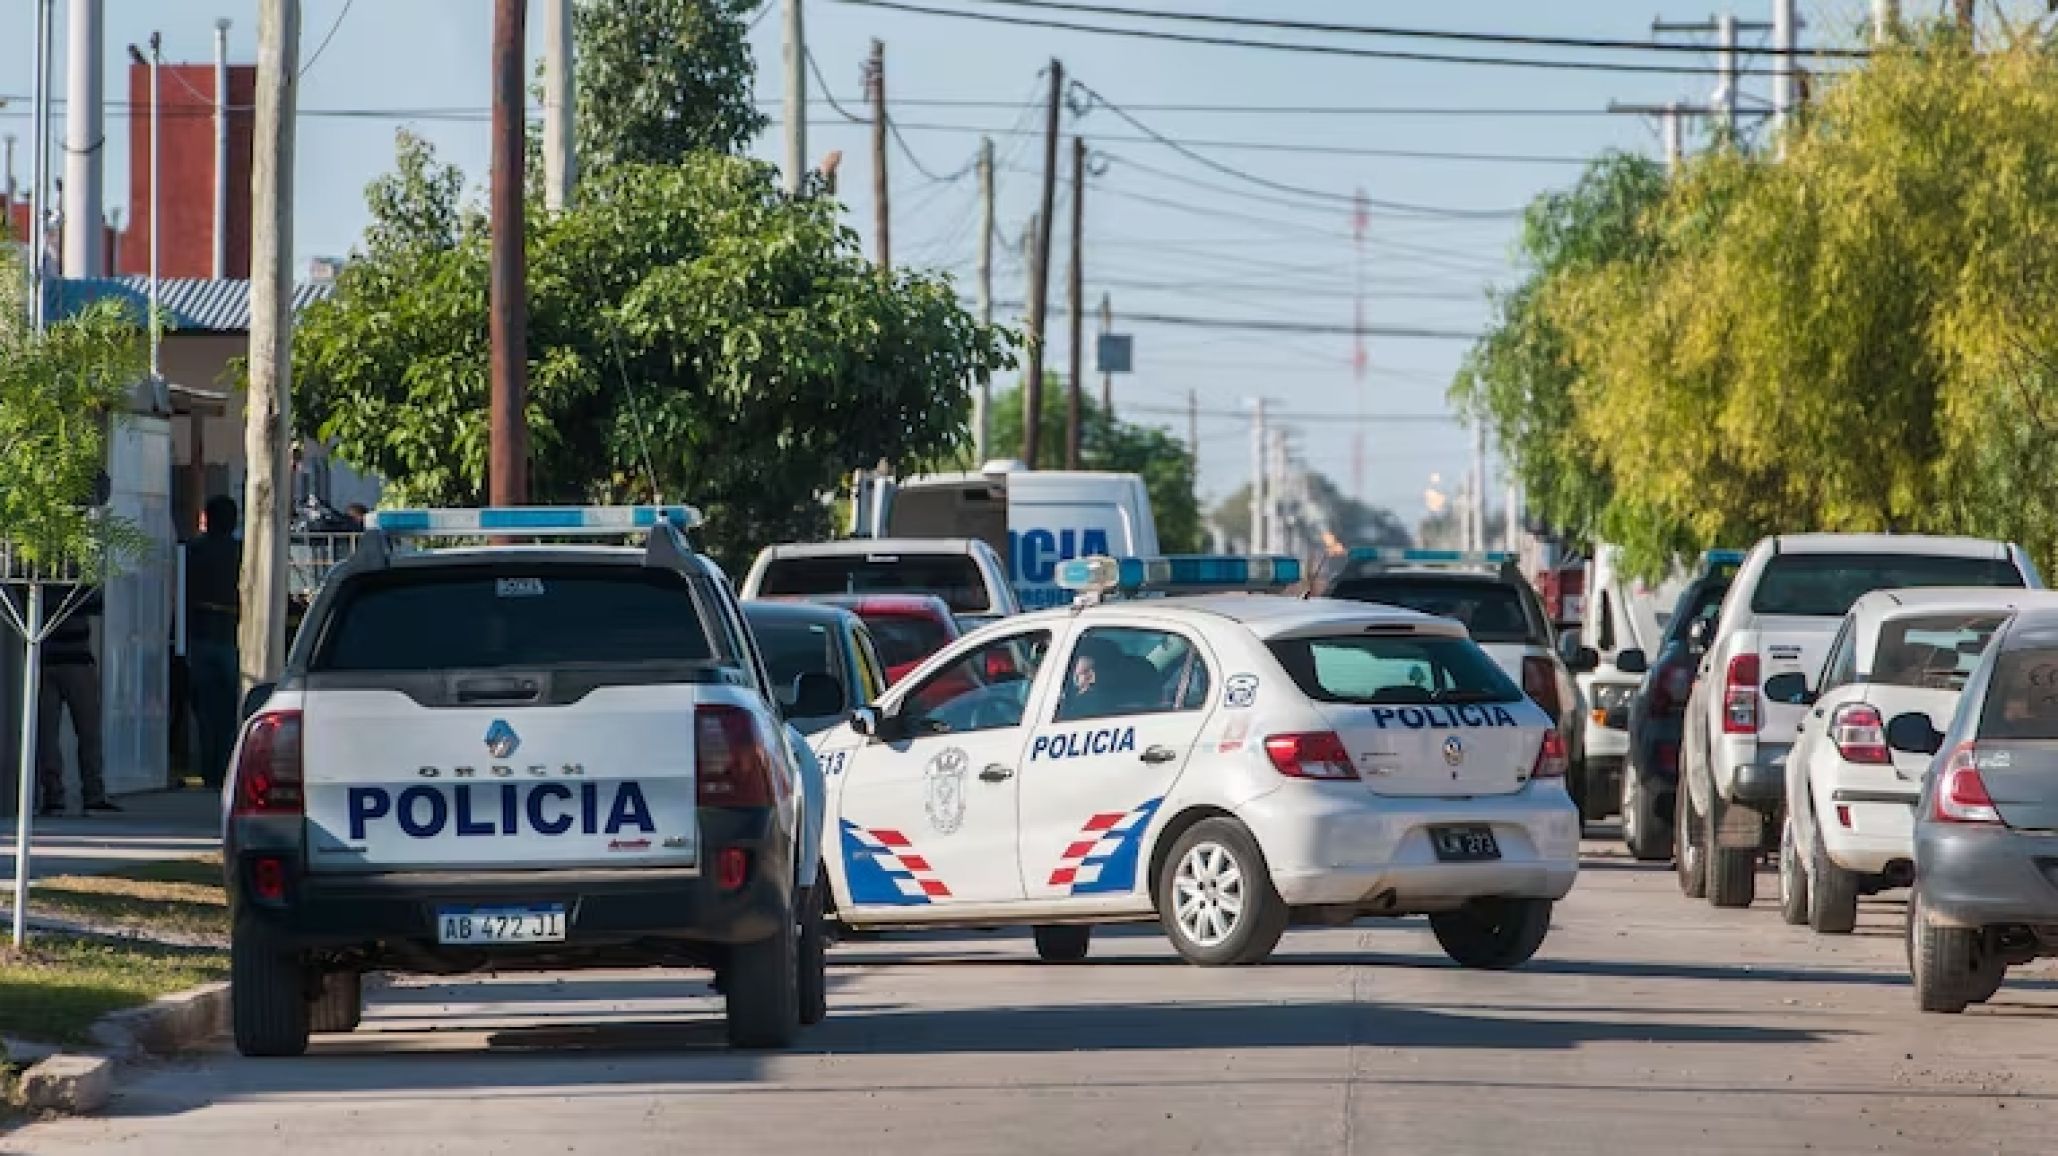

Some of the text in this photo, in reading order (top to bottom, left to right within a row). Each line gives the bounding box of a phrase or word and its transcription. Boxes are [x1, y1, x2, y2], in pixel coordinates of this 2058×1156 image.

[1371, 705, 1518, 728] POLICIA
[1030, 726, 1135, 761] POLICIA
[347, 780, 657, 839] POLICIA
[446, 916, 472, 939] AB
[481, 915, 523, 939] 472
